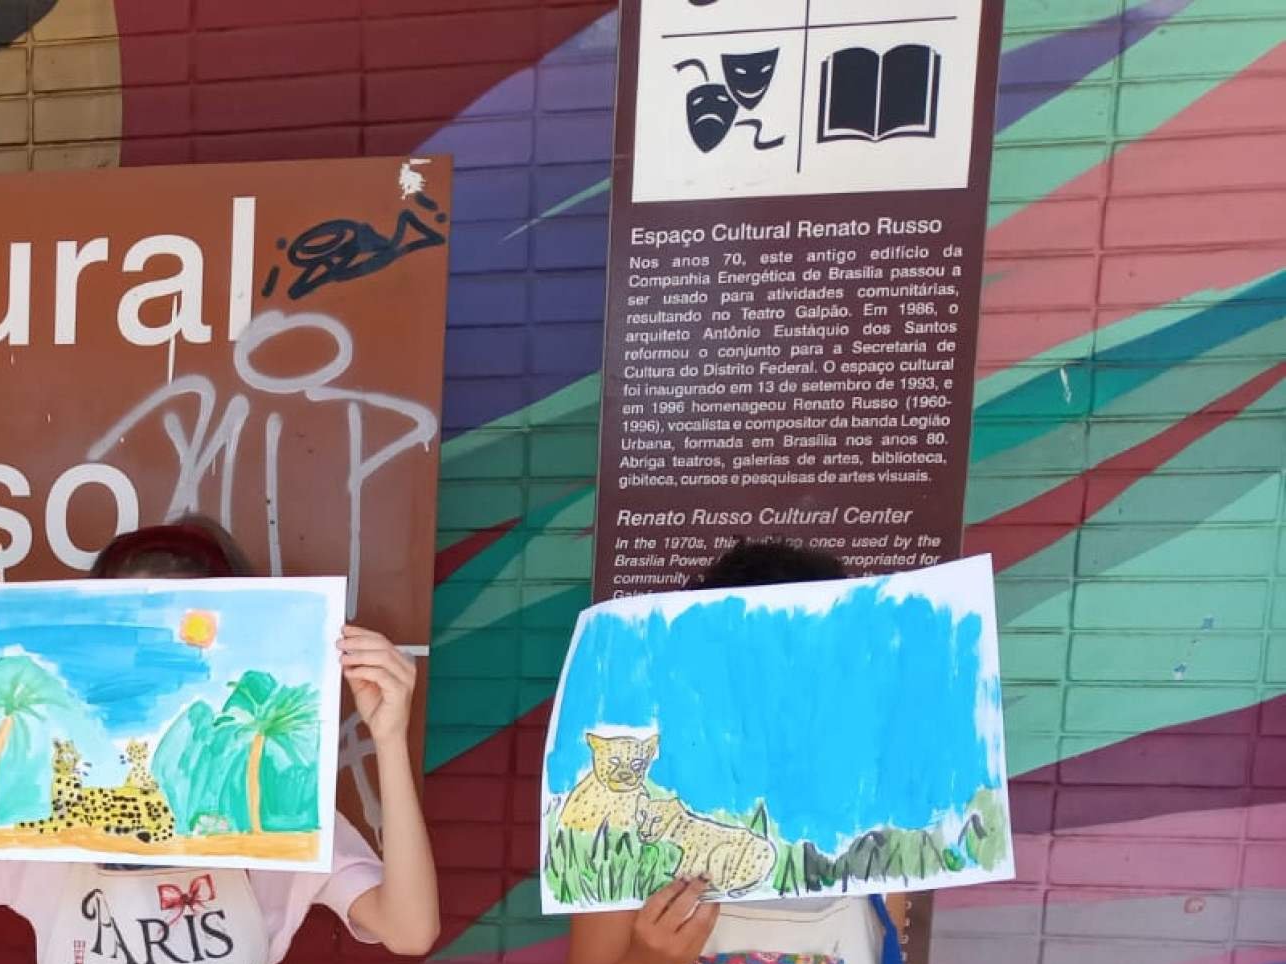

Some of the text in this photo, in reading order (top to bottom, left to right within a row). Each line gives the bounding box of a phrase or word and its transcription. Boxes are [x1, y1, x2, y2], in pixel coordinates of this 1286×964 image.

[631, 217, 942, 248] Espaço Cultural Renato Russo
[629, 256, 659, 269] Nos
[672, 255, 710, 268] anos
[760, 251, 793, 264] este
[806, 249, 856, 264] antigo
[943, 244, 963, 258] da
[628, 272, 710, 288] Companhia
[718, 269, 796, 286] Energética
[802, 268, 821, 281] de
[890, 265, 945, 282] passou
[952, 266, 962, 278] a
[627, 295, 650, 306] ser
[663, 290, 708, 304] usado
[721, 290, 754, 305] para
[767, 286, 844, 301] atividades
[626, 309, 702, 324] resultando
[712, 310, 730, 321] no
[741, 306, 786, 320] Teatro
[864, 304, 888, 316] Em
[948, 304, 959, 315] o
[625, 328, 690, 344] arquiteto
[862, 322, 892, 336] dos
[904, 320, 958, 334] Santos
[624, 340, 956, 360] reformou o conjunto para a Secretaria de
[624, 364, 675, 379] Cultura
[680, 364, 698, 377] do
[704, 362, 754, 376] Distrito
[822, 360, 836, 372] O
[840, 360, 894, 375] espaço
[900, 358, 954, 372] cultural
[624, 384, 641, 396] foi
[645, 382, 726, 398] inaugurado
[730, 383, 752, 394] em
[758, 380, 774, 393] 13
[778, 380, 796, 392] de
[802, 378, 872, 393] setembro
[876, 378, 894, 390] de
[944, 378, 954, 390] e
[622, 402, 644, 414] em
[691, 400, 786, 414] homenageou
[794, 398, 844, 411] Renato
[852, 396, 898, 410] Russo
[668, 418, 731, 432] vocalista
[732, 419, 742, 430] e
[746, 416, 826, 432] compositor
[830, 416, 848, 428] da
[852, 414, 898, 428] banda
[684, 436, 744, 448] formada
[752, 436, 774, 448] em
[846, 434, 872, 446] nos
[882, 434, 918, 446] anos
[619, 456, 665, 470] Abriga
[732, 453, 790, 470] galerias
[796, 452, 816, 466] de
[680, 474, 728, 486] cursos
[730, 474, 740, 486] e
[742, 471, 816, 487] pesquisas
[818, 470, 835, 483] de
[838, 470, 875, 484] artes
[616, 506, 914, 526] Renato Russo Cultural Center
[614, 536, 628, 549] In
[634, 536, 656, 548] the
[810, 536, 846, 548] once
[852, 534, 889, 548] used
[894, 534, 912, 550] by
[918, 534, 942, 548] the
[668, 554, 714, 566] Power
[919, 552, 940, 566] for
[614, 572, 690, 588] community
